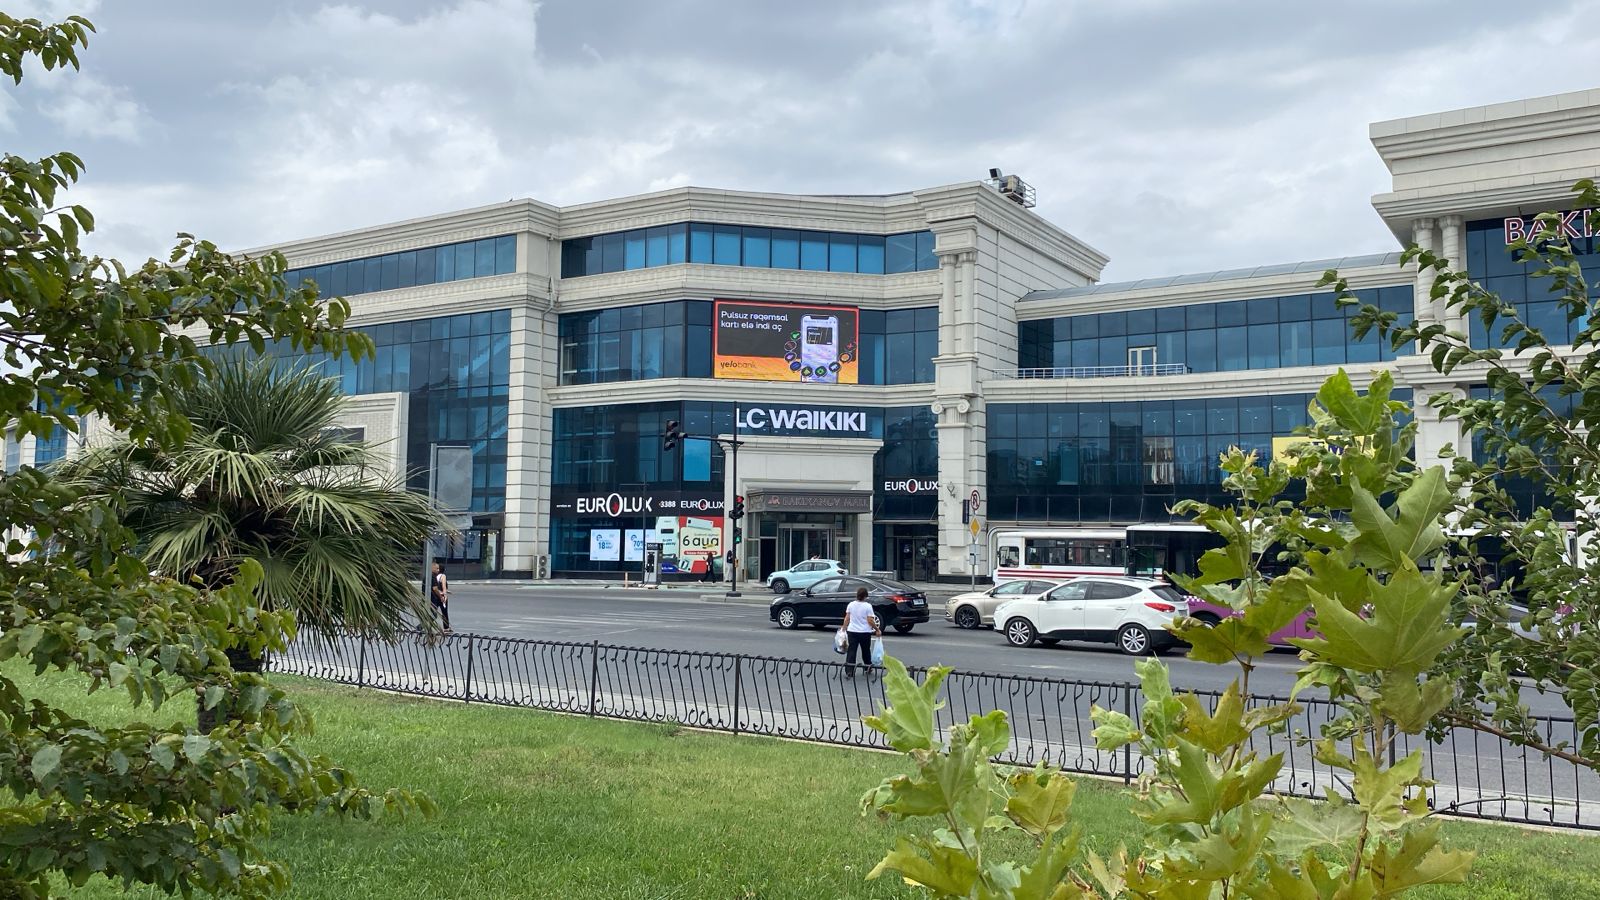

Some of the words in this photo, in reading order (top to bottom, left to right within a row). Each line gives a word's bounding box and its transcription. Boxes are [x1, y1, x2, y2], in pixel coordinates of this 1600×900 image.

[721, 311, 749, 320] Pulsuz
[755, 321, 770, 330] indi
[736, 408, 766, 429] LC
[885, 479, 938, 493] EUROLUX
[577, 493, 652, 517] EUROLUX
[681, 499, 724, 511] EUROLUX
[598, 541, 606, 550] 18
[683, 535, 690, 546] 6
